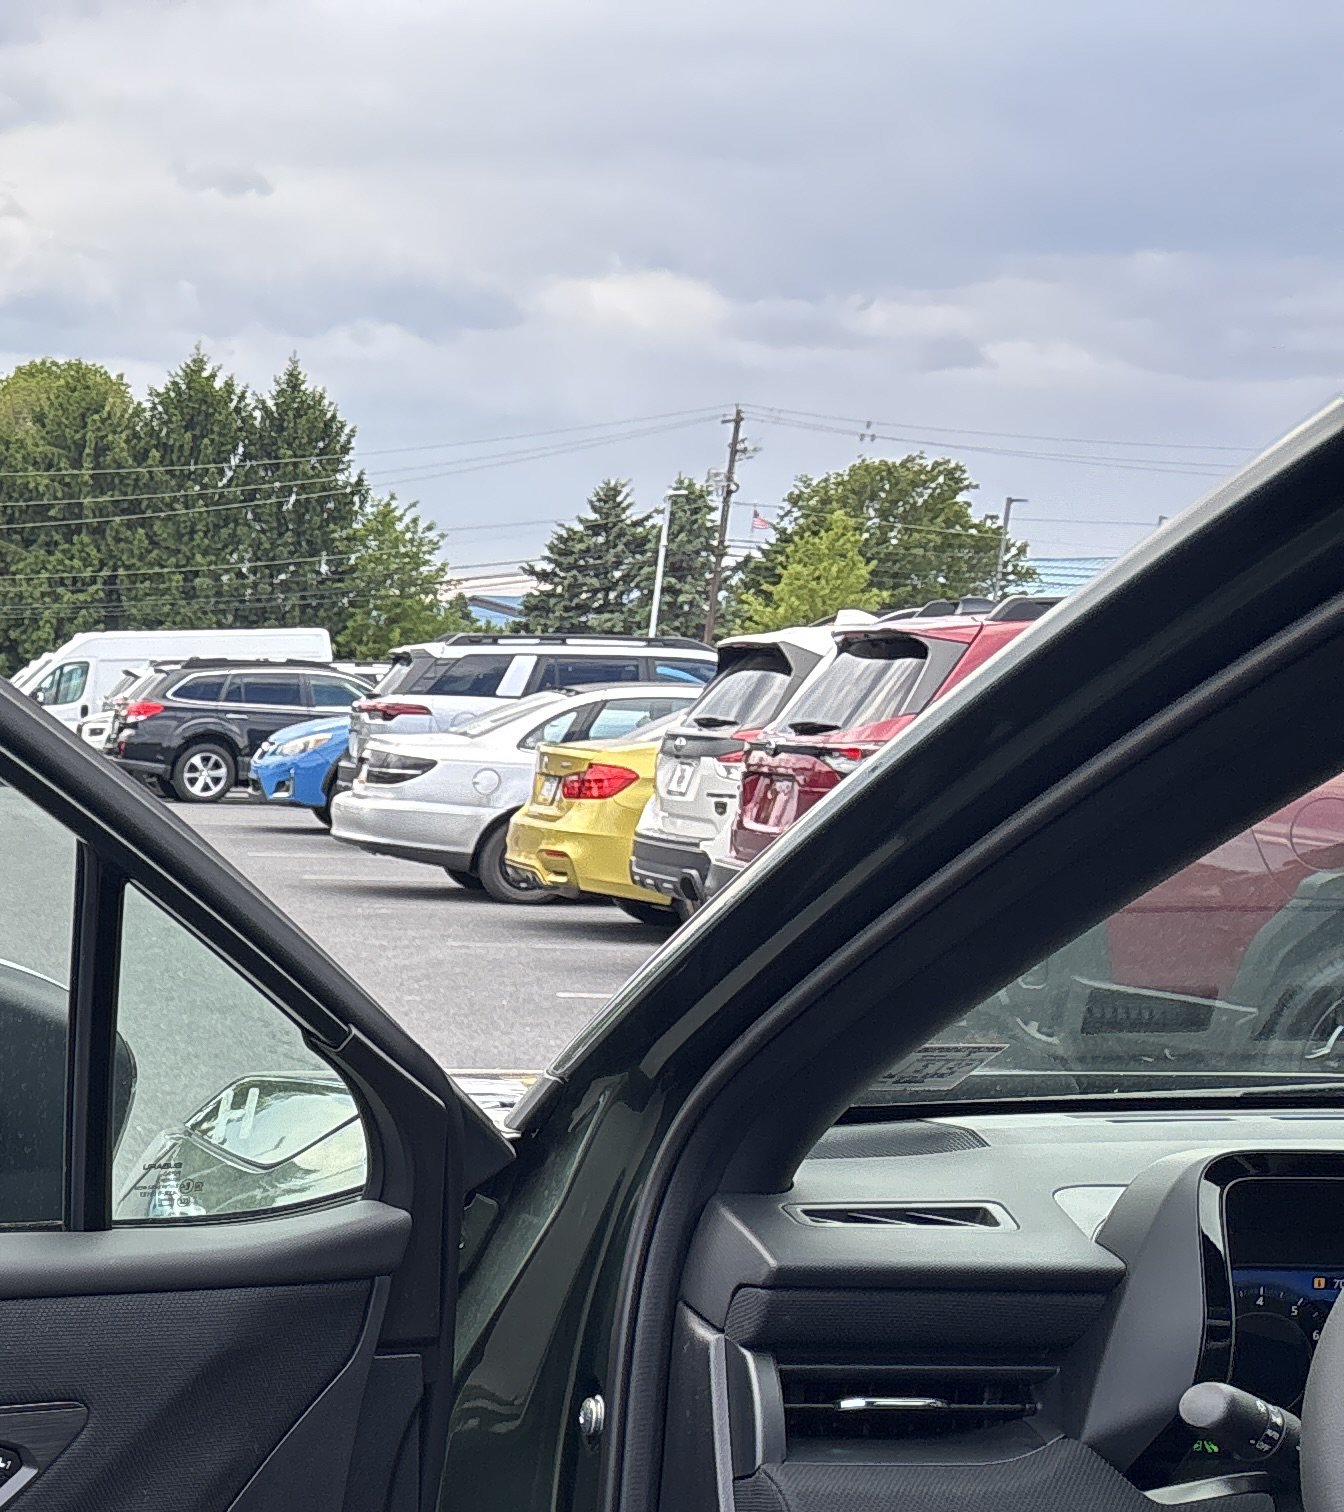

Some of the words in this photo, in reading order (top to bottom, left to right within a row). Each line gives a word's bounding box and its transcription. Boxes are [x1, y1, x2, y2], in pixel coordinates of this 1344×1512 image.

[1255, 1296, 1265, 1307] 4
[1290, 1305, 1299, 1316] 5
[1312, 1329, 1321, 1341] 6
